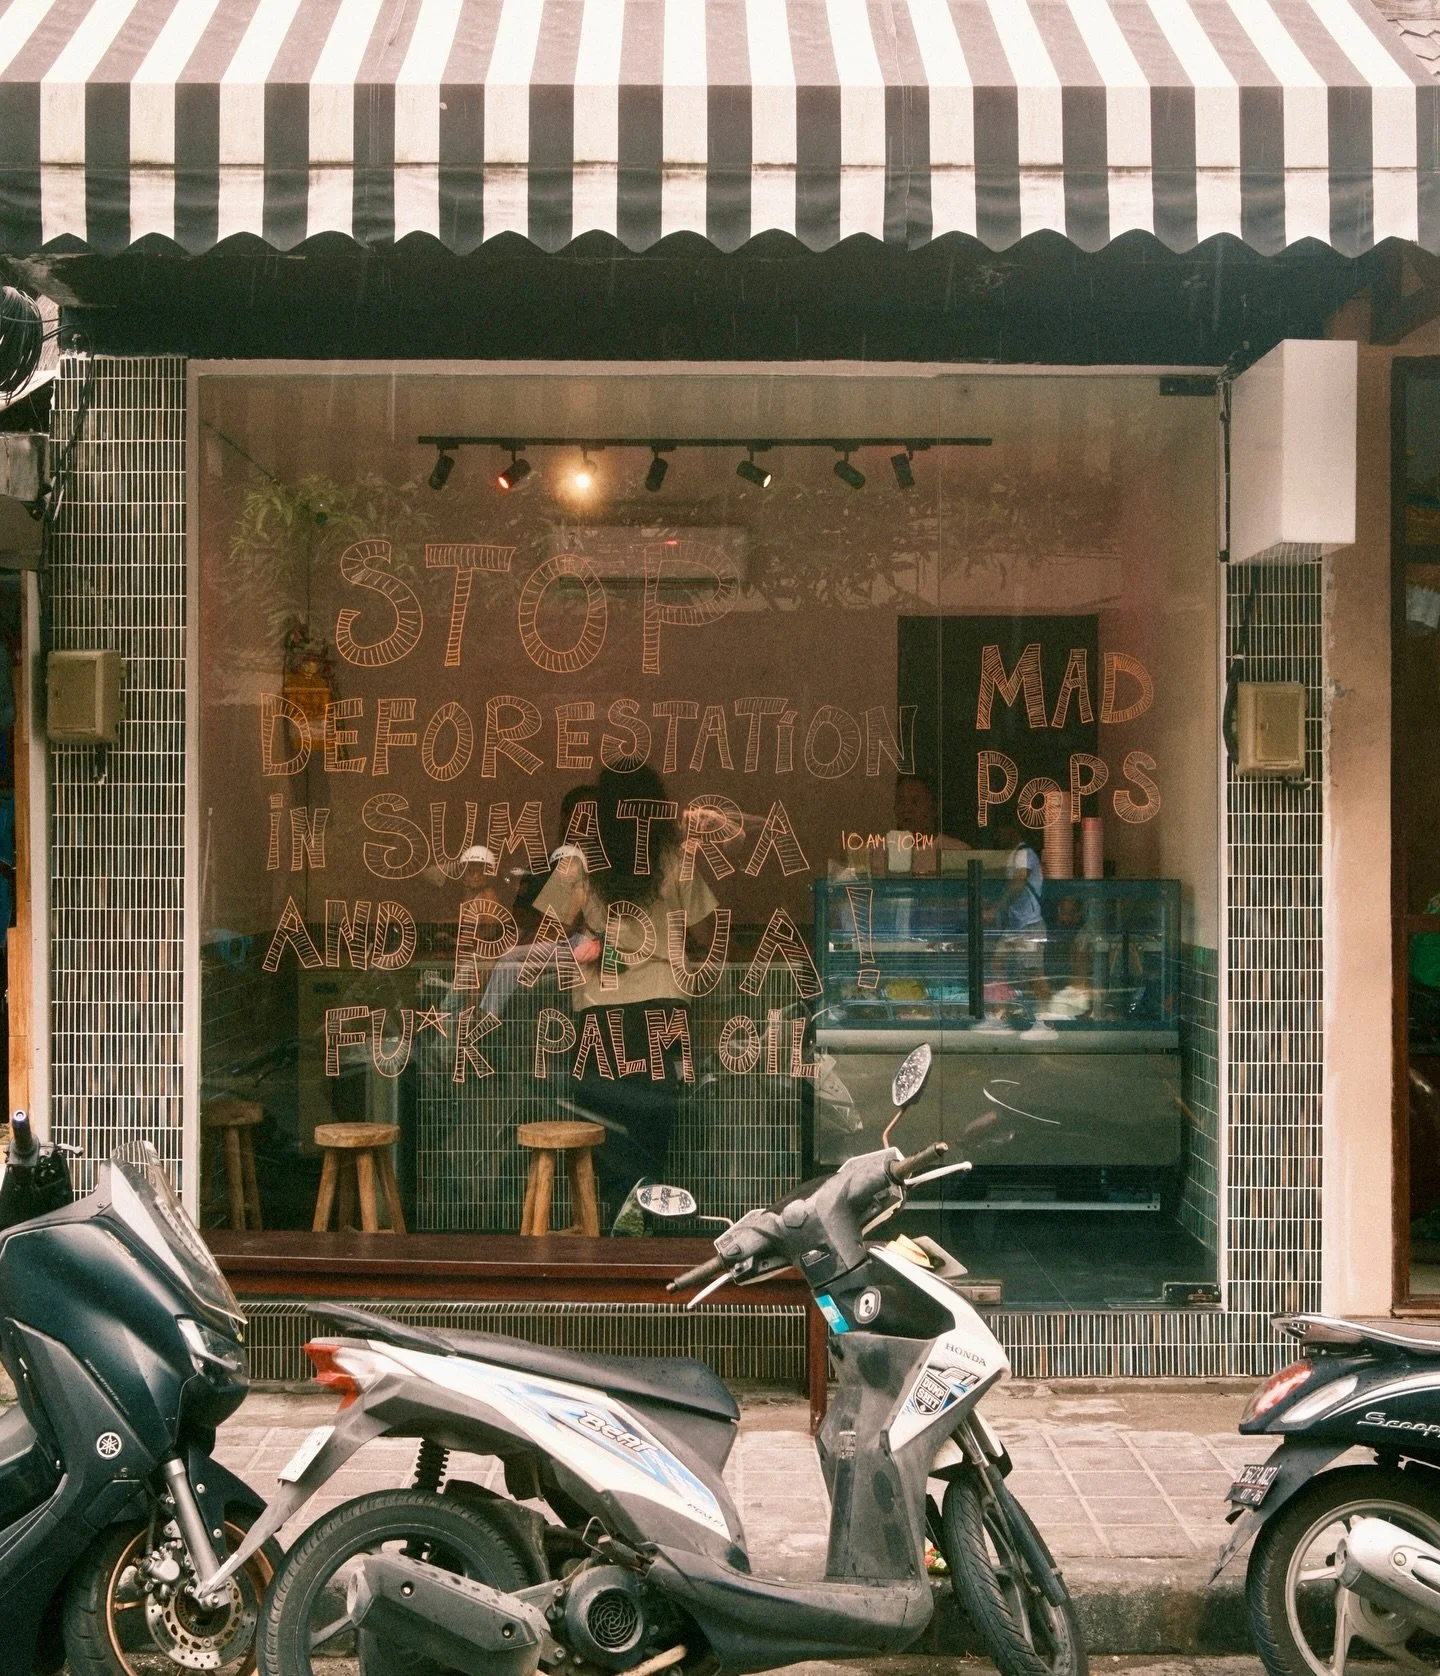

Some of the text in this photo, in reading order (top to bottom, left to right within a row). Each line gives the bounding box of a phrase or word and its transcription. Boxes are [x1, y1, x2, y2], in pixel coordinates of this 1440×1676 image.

[336, 539, 741, 674] STOP
[976, 643, 1154, 730] MAD
[362, 793, 811, 880] SUMATRA
[262, 896, 418, 973] AND
[453, 898, 824, 1000] PAPUA
[534, 1007, 696, 1084] PALM
[921, 1377, 946, 1399] DUMP
[945, 1343, 987, 1367] HONDA
[916, 1389, 940, 1409] SHIT
[1356, 1411, 1440, 1438] Scoop
